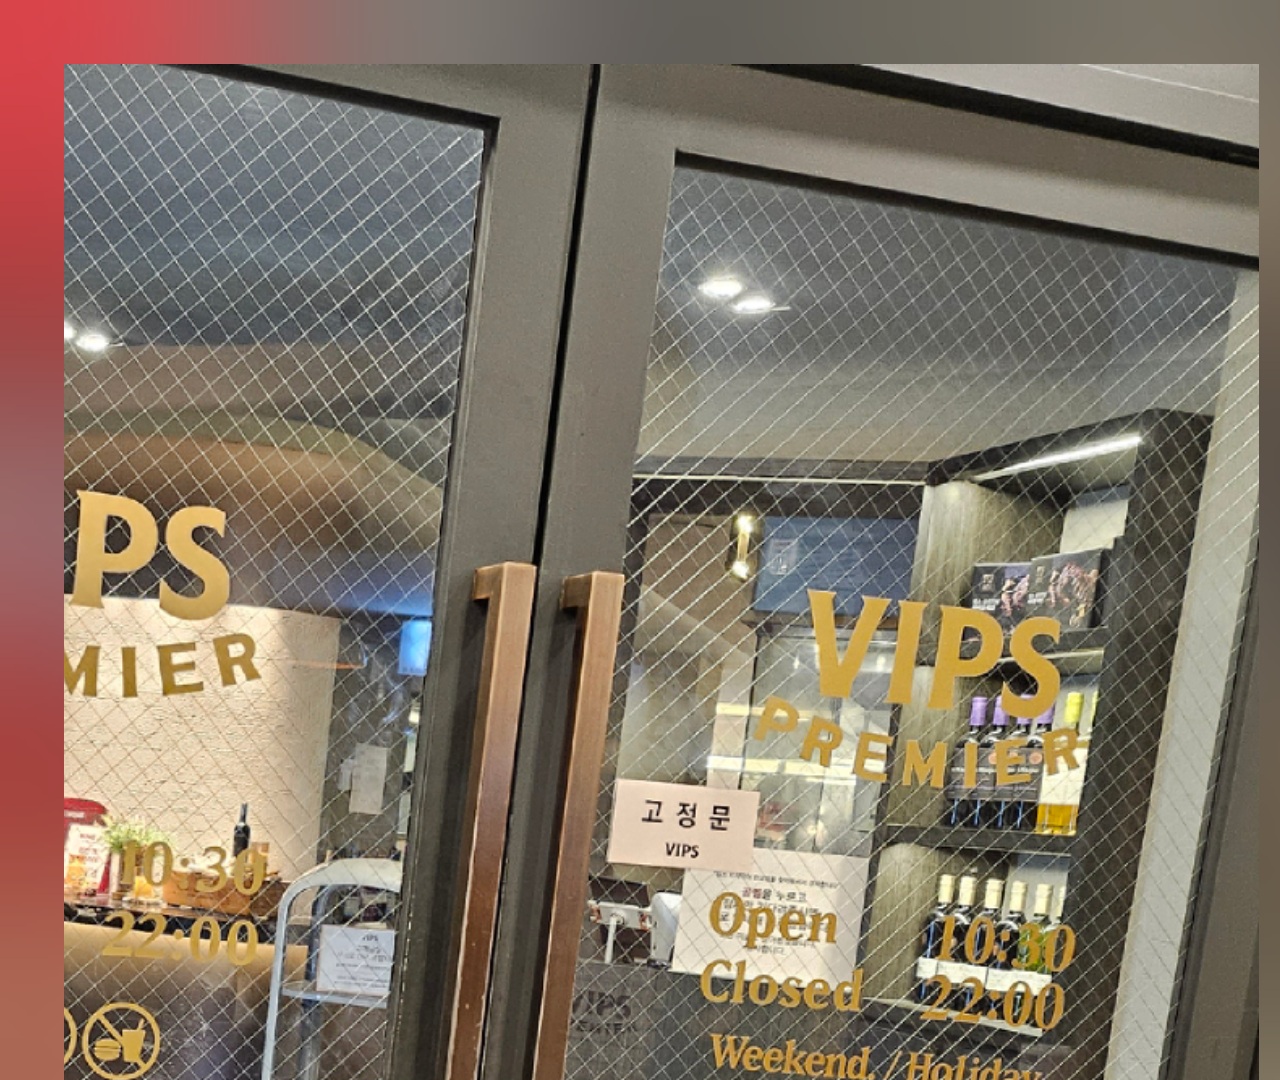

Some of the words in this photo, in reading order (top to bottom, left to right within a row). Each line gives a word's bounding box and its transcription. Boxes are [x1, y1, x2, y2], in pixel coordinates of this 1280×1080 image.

[808, 589, 1062, 719] VIPS
[753, 696, 1081, 788] PREMIER
[119, 841, 266, 895] 10:30
[664, 842, 700, 859] VIPS
[102, 911, 259, 966] 22:00
[709, 891, 838, 949] Open
[936, 914, 1077, 972] 10:30
[700, 959, 865, 1012] Closed
[920, 975, 1066, 1031] 22:00
